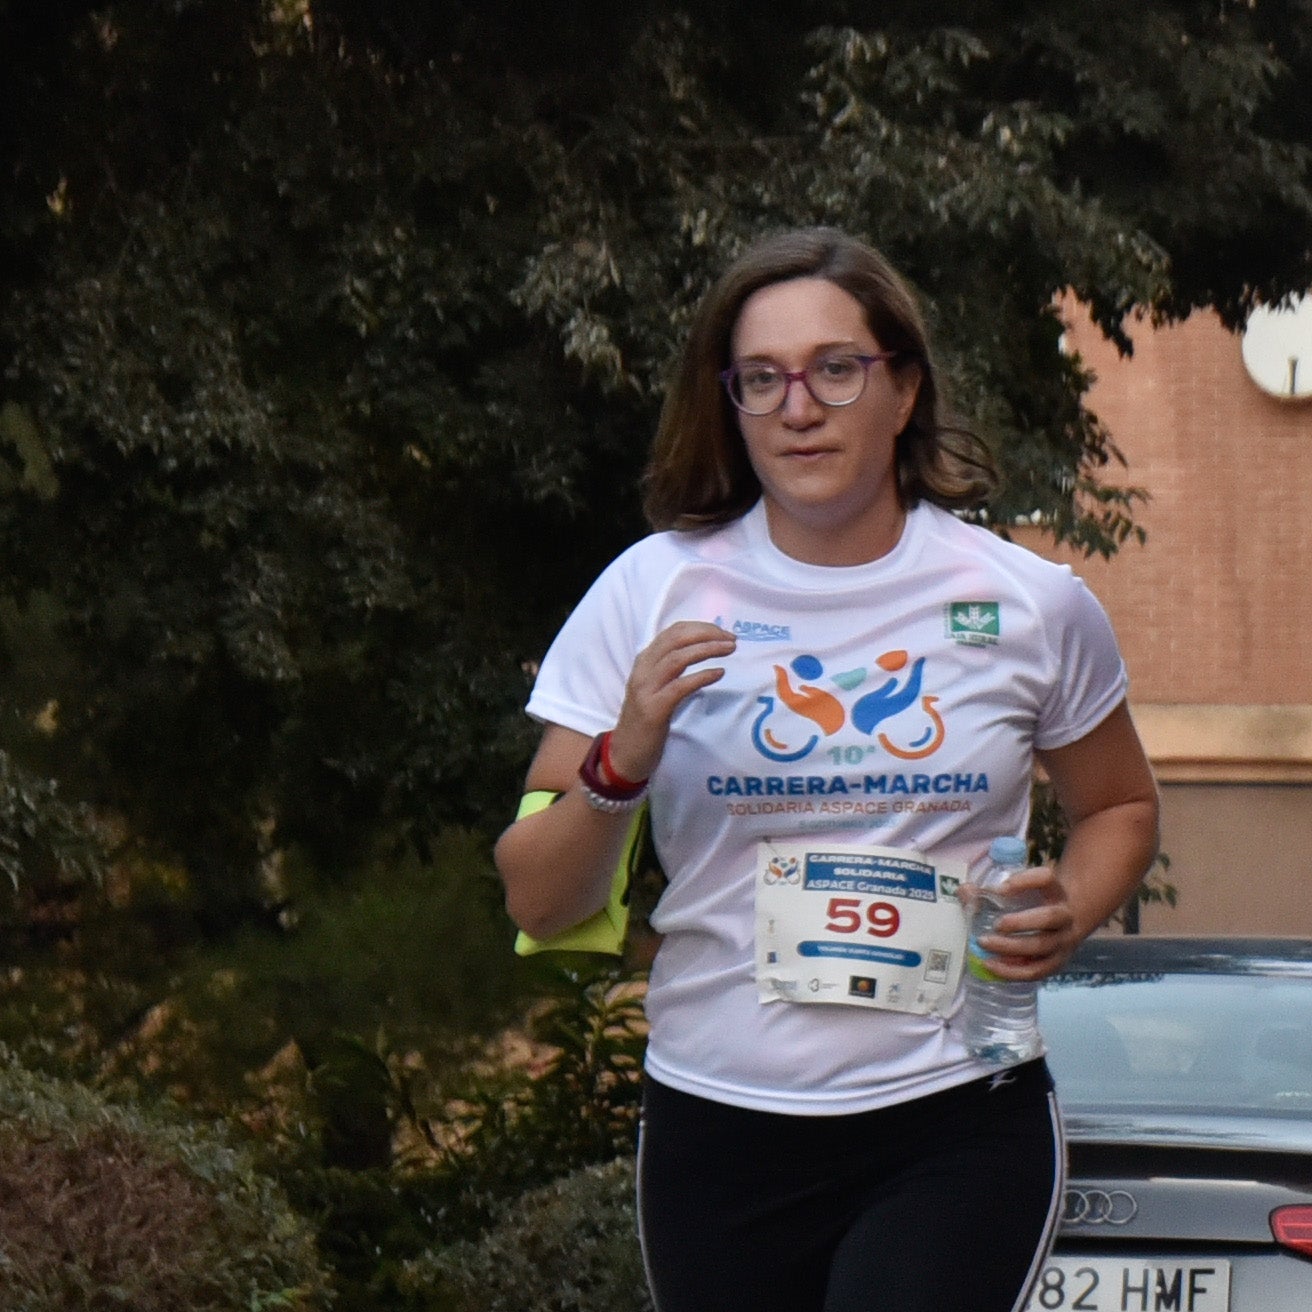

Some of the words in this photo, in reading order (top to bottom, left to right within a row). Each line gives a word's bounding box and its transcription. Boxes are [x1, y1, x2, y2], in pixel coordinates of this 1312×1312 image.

[706, 773, 989, 797] CARRERA-MARCHA
[727, 801, 815, 817] SOLIDARIA
[820, 800, 888, 815] ASPACE
[892, 798, 971, 814] GRANADA
[833, 866, 905, 881] SOLIDARIA
[806, 879, 855, 891] ASPACE
[856, 880, 907, 896] Granada
[908, 887, 935, 901] 2025
[824, 898, 900, 938] 59
[1120, 1267, 1216, 1312] HMF
